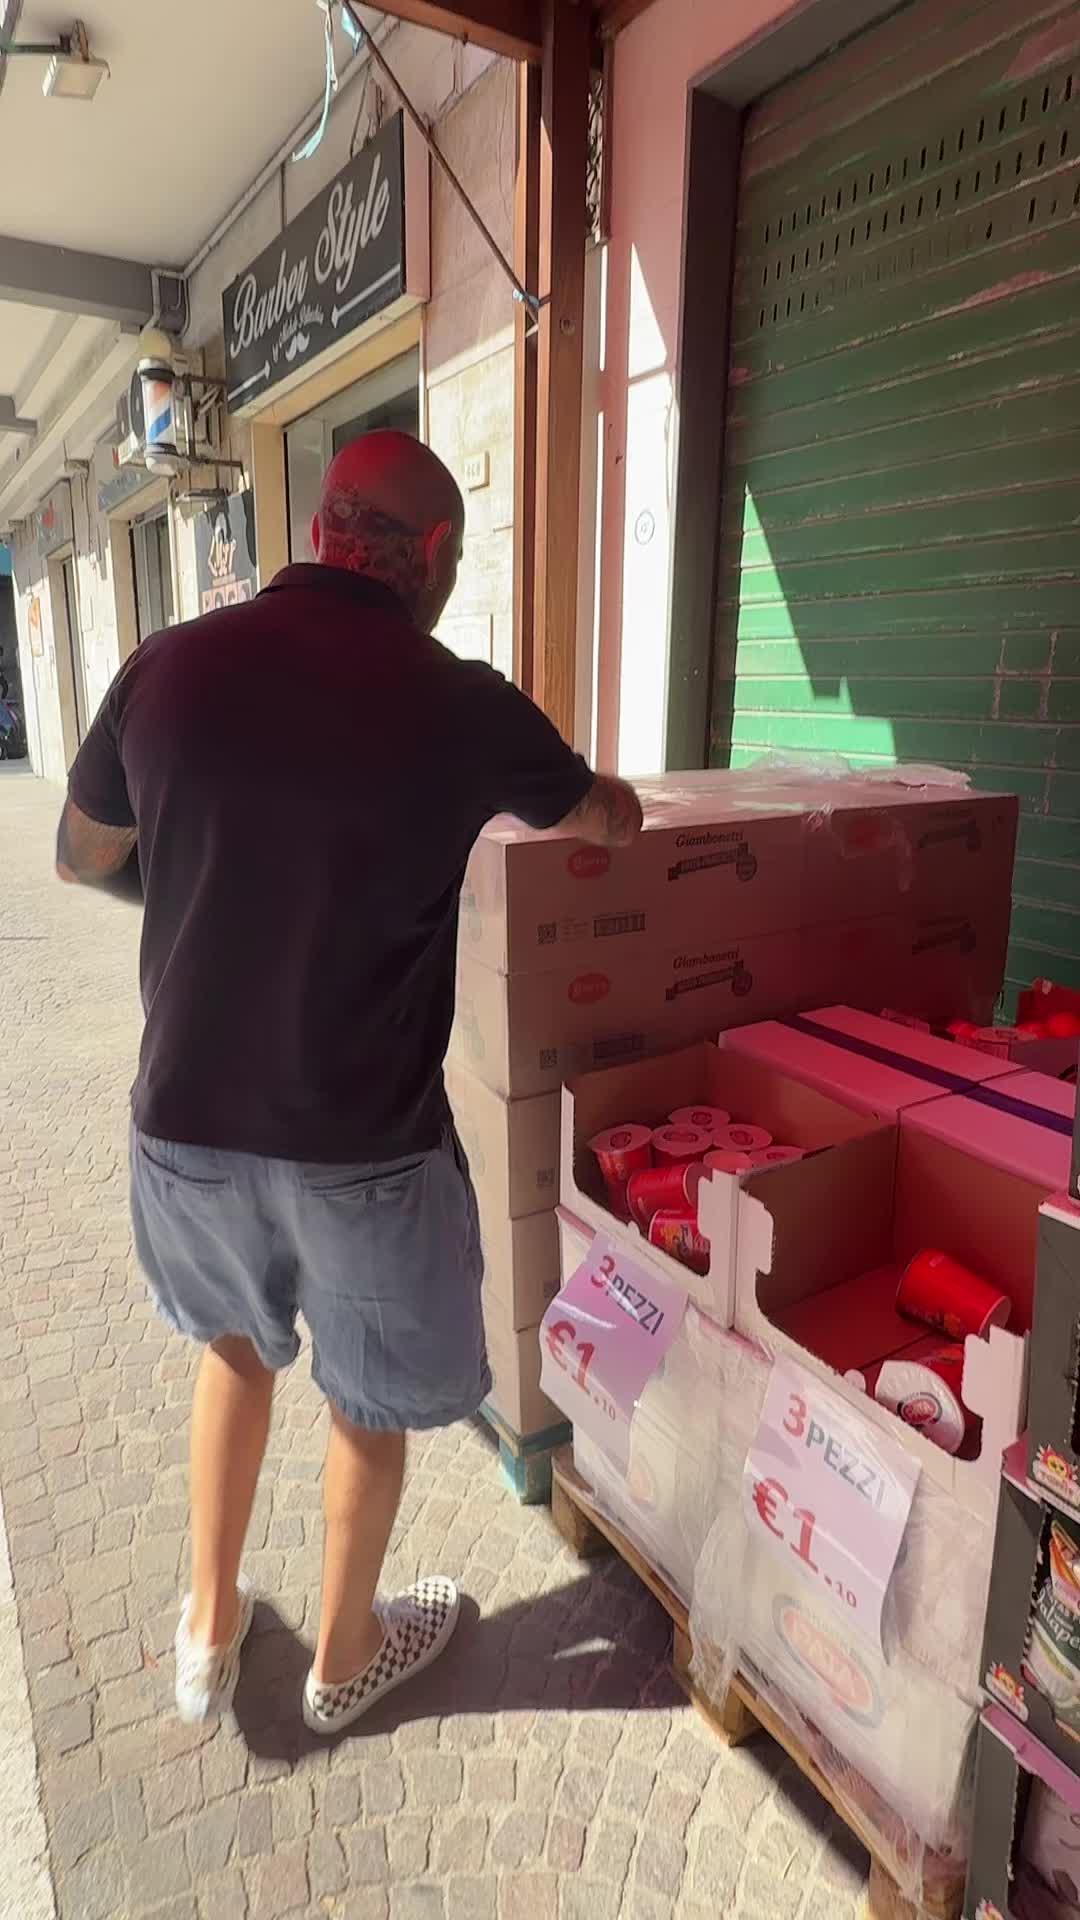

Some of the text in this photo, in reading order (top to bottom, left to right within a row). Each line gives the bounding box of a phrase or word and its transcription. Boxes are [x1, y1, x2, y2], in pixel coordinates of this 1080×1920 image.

[229, 248, 308, 360] Barber
[314, 152, 391, 294] Style
[604, 1272, 665, 1336] PEZZI
[782, 1392, 886, 1508] 3 PEZZI
